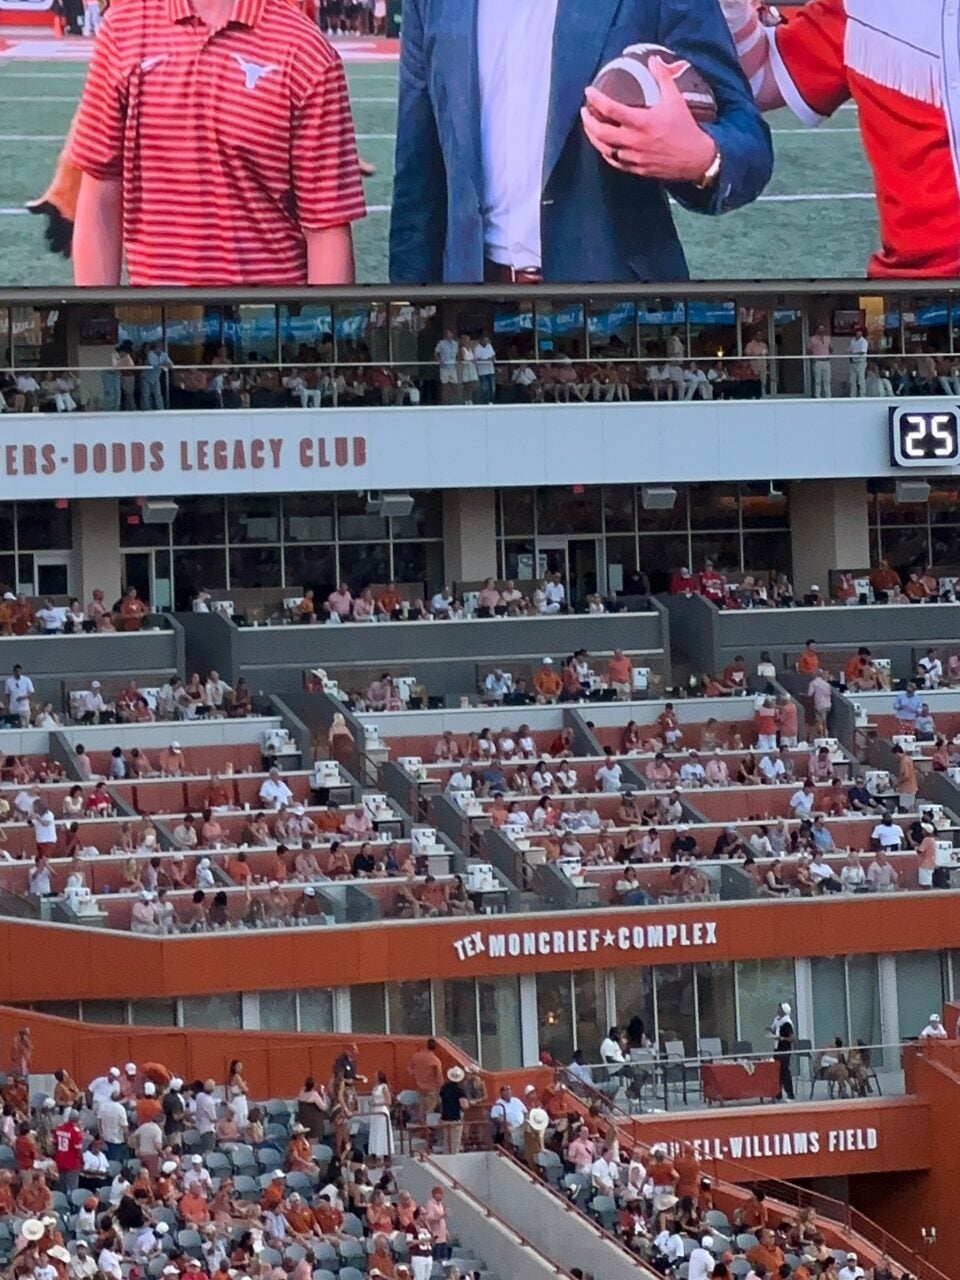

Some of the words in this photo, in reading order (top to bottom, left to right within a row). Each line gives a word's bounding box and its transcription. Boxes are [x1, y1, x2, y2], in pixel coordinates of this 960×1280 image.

[180, 438, 284, 472] LEGACY
[298, 436, 368, 469] CLUB
[905, 415, 954, 457] 25
[453, 930, 486, 961] TEX
[488, 928, 600, 958] MONCRIEF
[617, 922, 718, 950] COMPLEX
[828, 1127, 878, 1153] FIELD
